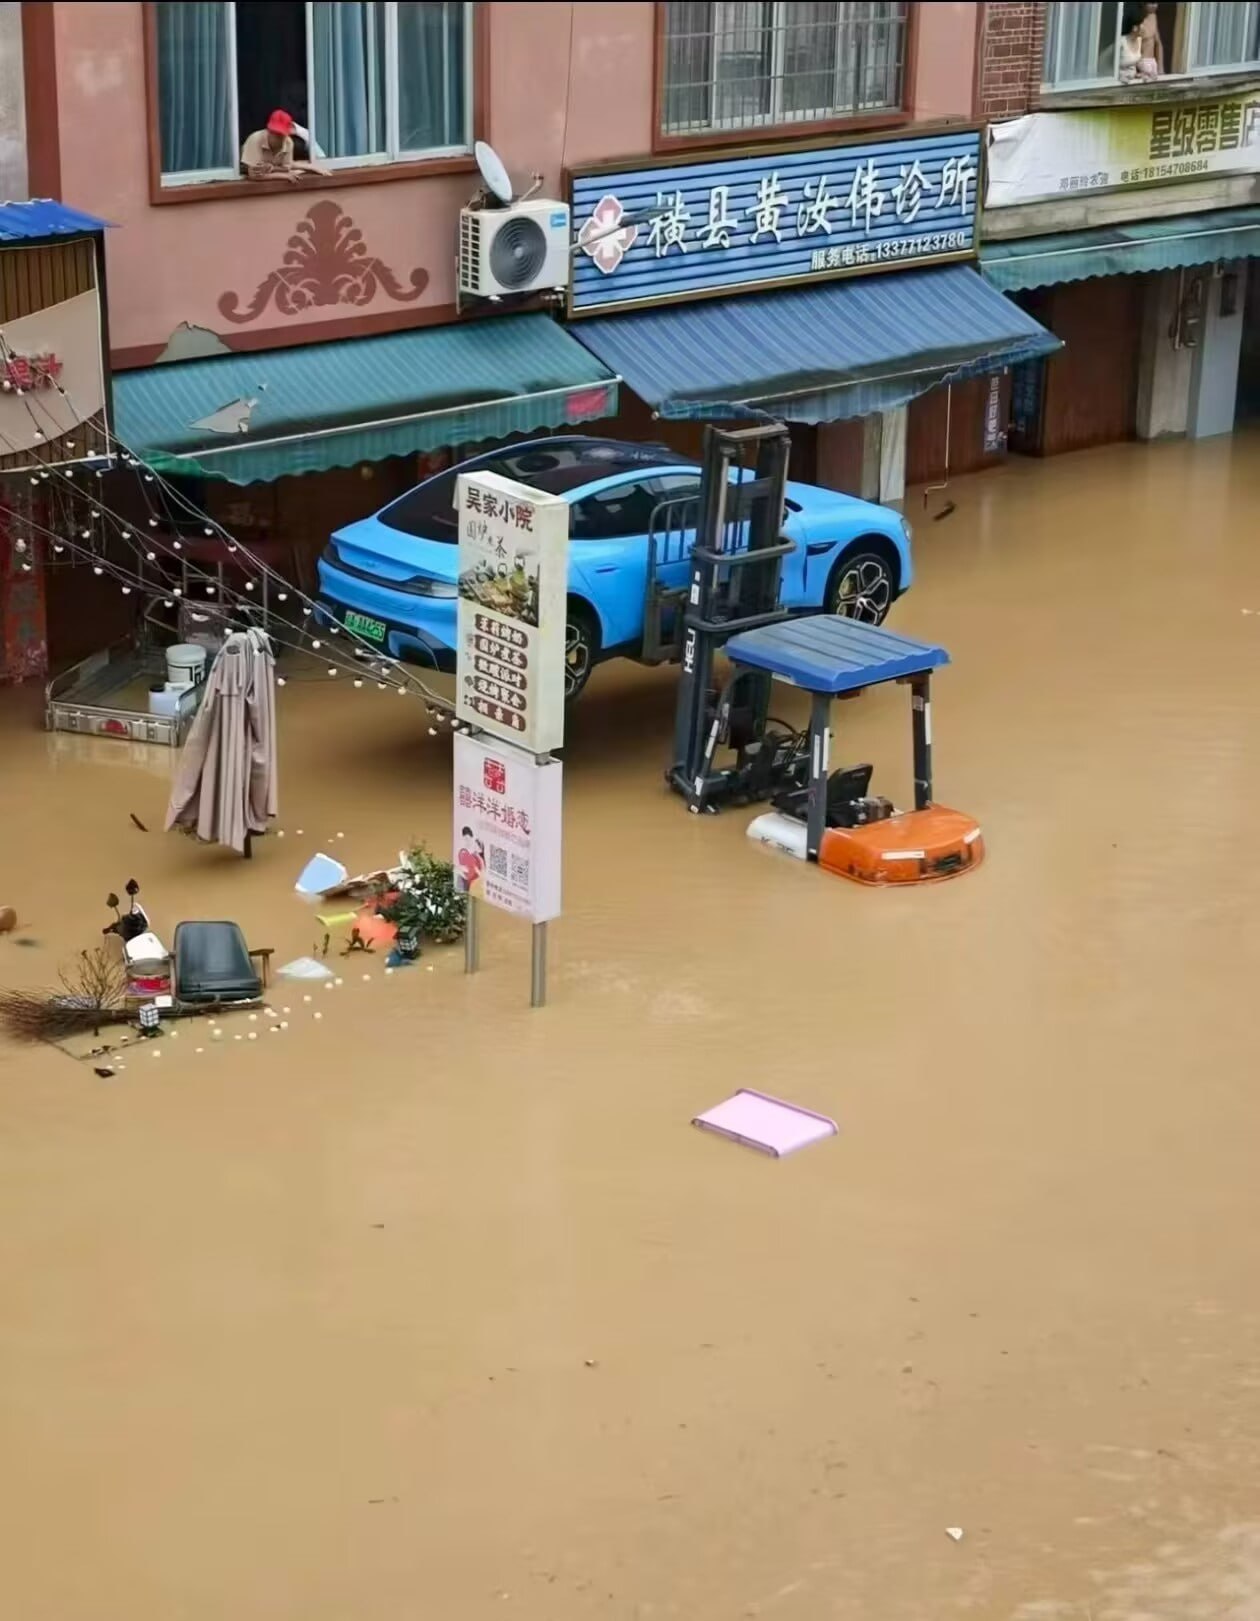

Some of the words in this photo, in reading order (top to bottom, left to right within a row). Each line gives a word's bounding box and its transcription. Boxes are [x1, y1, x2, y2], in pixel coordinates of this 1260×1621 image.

[646, 153, 977, 258] 横县黄汝伟诊所
[466, 486, 535, 533] 吴家小院
[684, 628, 696, 673] HELI
